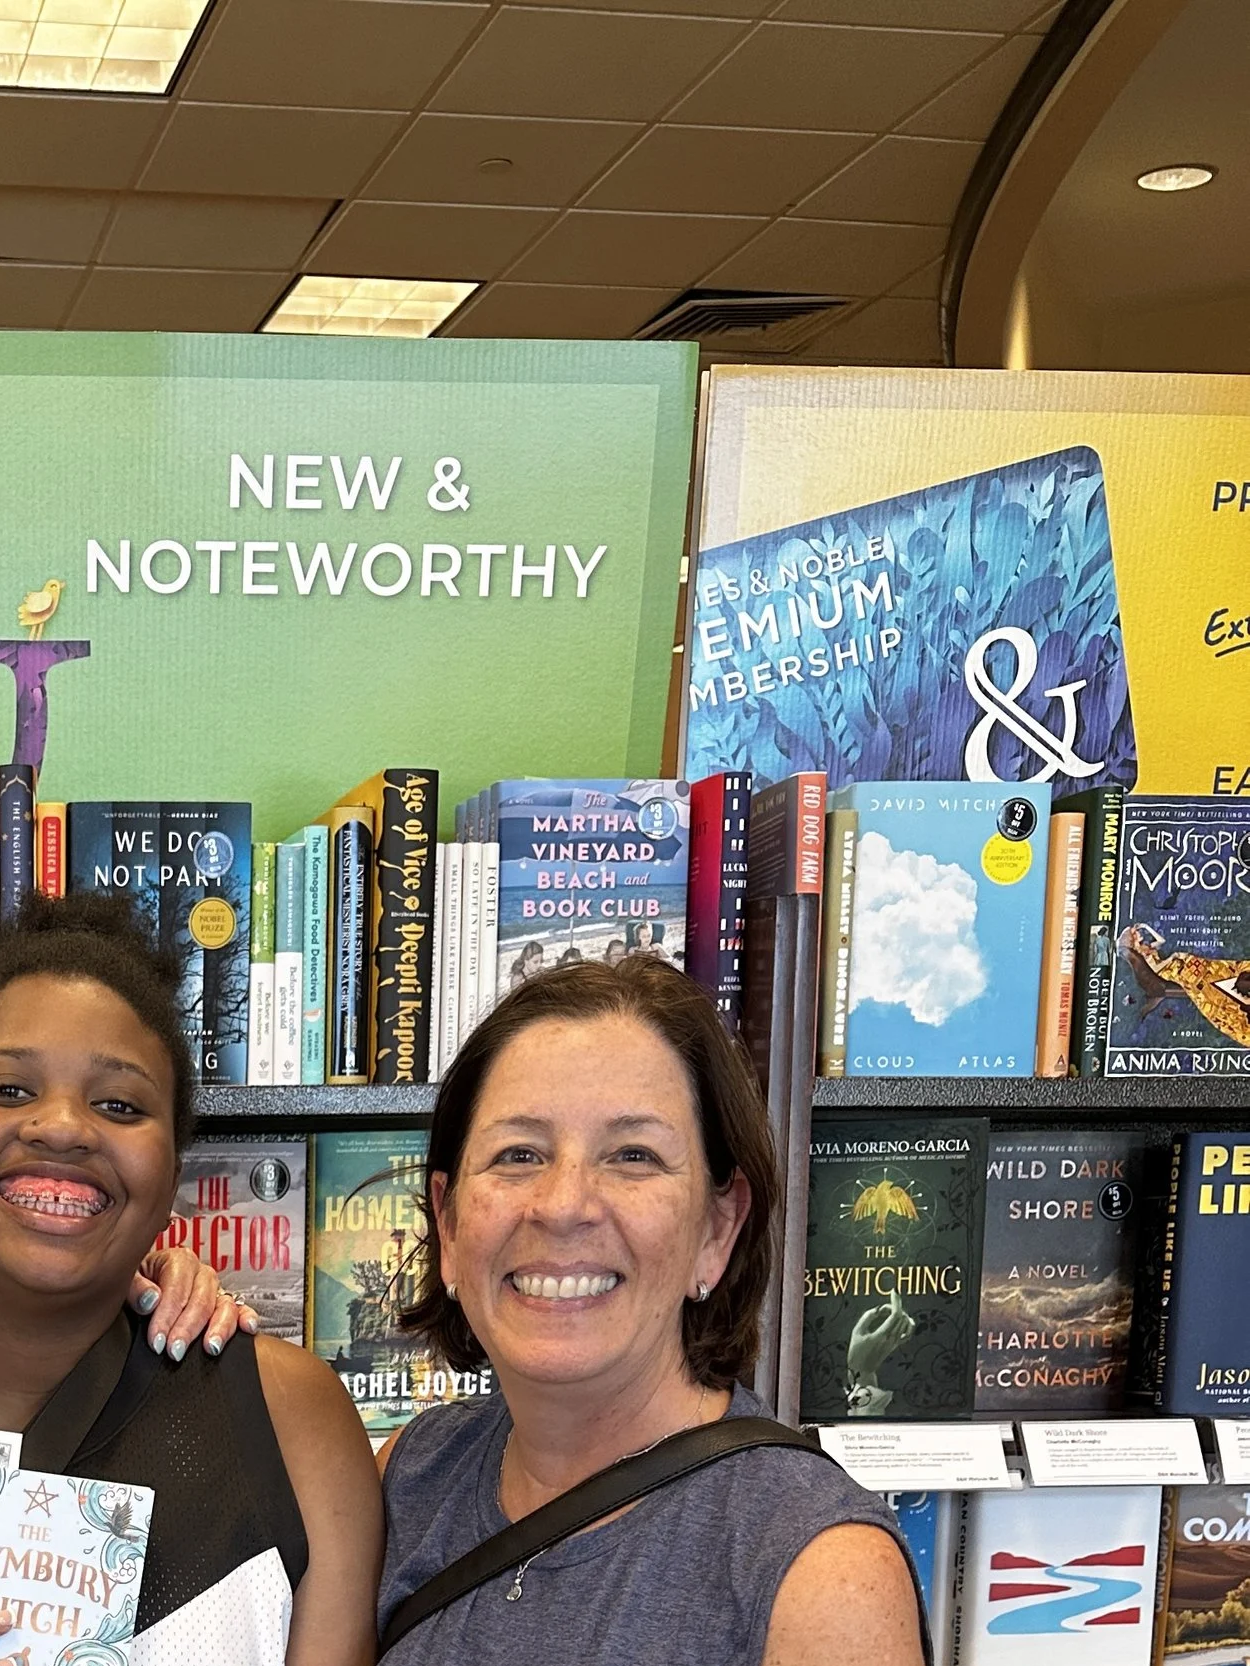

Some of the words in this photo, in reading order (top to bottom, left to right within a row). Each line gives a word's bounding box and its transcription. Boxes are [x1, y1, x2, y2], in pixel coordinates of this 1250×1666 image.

[229, 453, 402, 512] NEW
[426, 457, 470, 512] &
[85, 540, 609, 599] NOTEWORTHY
[750, 569, 772, 595] &
[778, 536, 885, 587] NOBLE
[699, 572, 895, 662] EMIUM
[400, 773, 430, 813] Age
[583, 793, 607, 807] The
[803, 785, 821, 807] RED
[869, 799, 926, 812] DAVID
[404, 819, 428, 842] of
[802, 813, 821, 845] DOG
[1104, 814, 1119, 856] MARY
[115, 831, 154, 852] WE
[532, 843, 655, 861] VINEYARD
[94, 865, 147, 887] NOT
[403, 846, 428, 891] Vice
[800, 848, 818, 885] FARM
[538, 872, 616, 889] BEACH
[624, 872, 649, 885] and
[1099, 858, 1114, 921] MONROE
[523, 900, 591, 917] BOOK
[601, 900, 660, 917] CLUB
[395, 922, 425, 994] Deepti
[1089, 966, 1101, 997] NOT
[1100, 979, 1110, 1007] BENT
[1085, 999, 1099, 1052] BROKEN
[1098, 1014, 1108, 1041] BUT
[854, 1056, 915, 1069] CLOUD
[958, 1056, 1016, 1069] ATLAS
[1112, 1053, 1181, 1072] ANIMA
[845, 1138, 970, 1155] MORENO-GARCIA
[986, 1159, 1047, 1180] WILD
[1061, 1159, 1125, 1179] DARK
[1009, 1200, 1094, 1220] SHORE
[864, 1245, 897, 1259] THE
[1009, 1266, 1020, 1280] A
[1026, 1265, 1088, 1280] NOVEL
[417, 1370, 492, 1395] JOYCE
[841, 1433, 854, 1442] The
[856, 1432, 901, 1443] Bewitching
[1044, 1429, 1062, 1438] Wild
[18, 1524, 52, 1542] THE
